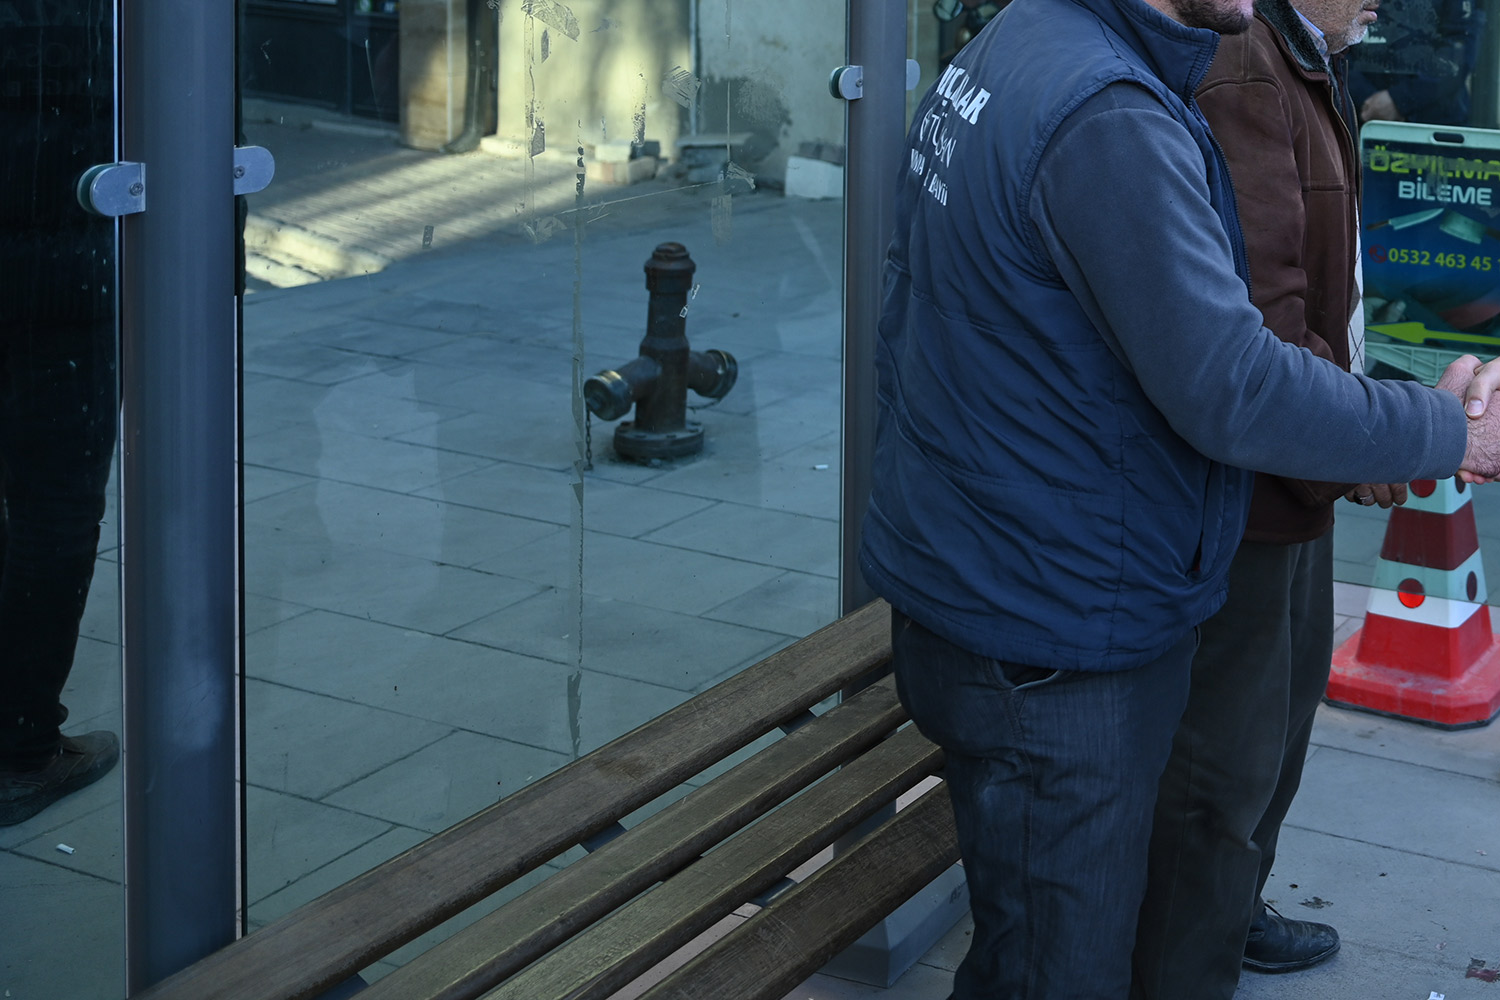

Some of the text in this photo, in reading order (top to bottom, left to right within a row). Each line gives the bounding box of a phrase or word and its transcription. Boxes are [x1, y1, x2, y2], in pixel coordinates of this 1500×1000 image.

[1398, 176, 1492, 206] BİLEME
[1388, 248, 1430, 266] 0532
[1434, 252, 1466, 269] 463
[1471, 255, 1492, 271] 45
